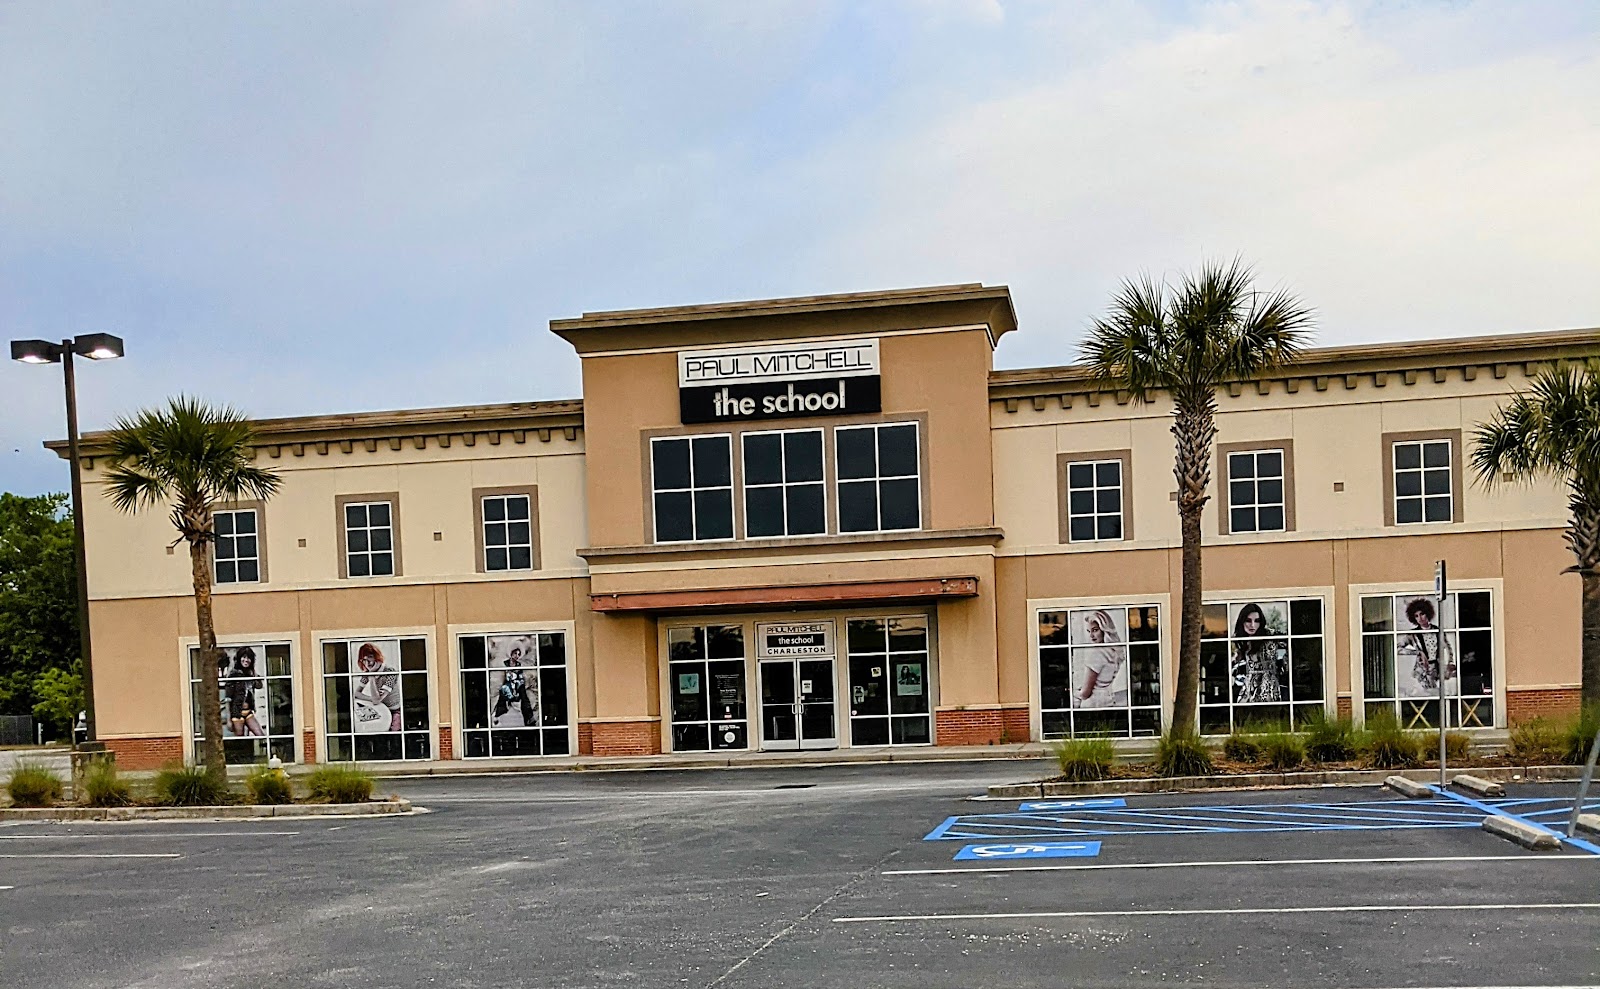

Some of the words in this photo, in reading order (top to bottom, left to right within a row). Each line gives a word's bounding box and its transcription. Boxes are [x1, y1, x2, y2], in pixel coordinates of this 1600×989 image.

[686, 358, 749, 378] PAUL
[753, 350, 871, 374] MITCHELL
[713, 387, 755, 416] the
[762, 379, 846, 413] school
[767, 626, 786, 634] PAUL
[787, 624, 826, 633] MITCHELL
[778, 637, 790, 645] the
[791, 635, 814, 645] school
[767, 647, 826, 655] CHARLESTON
